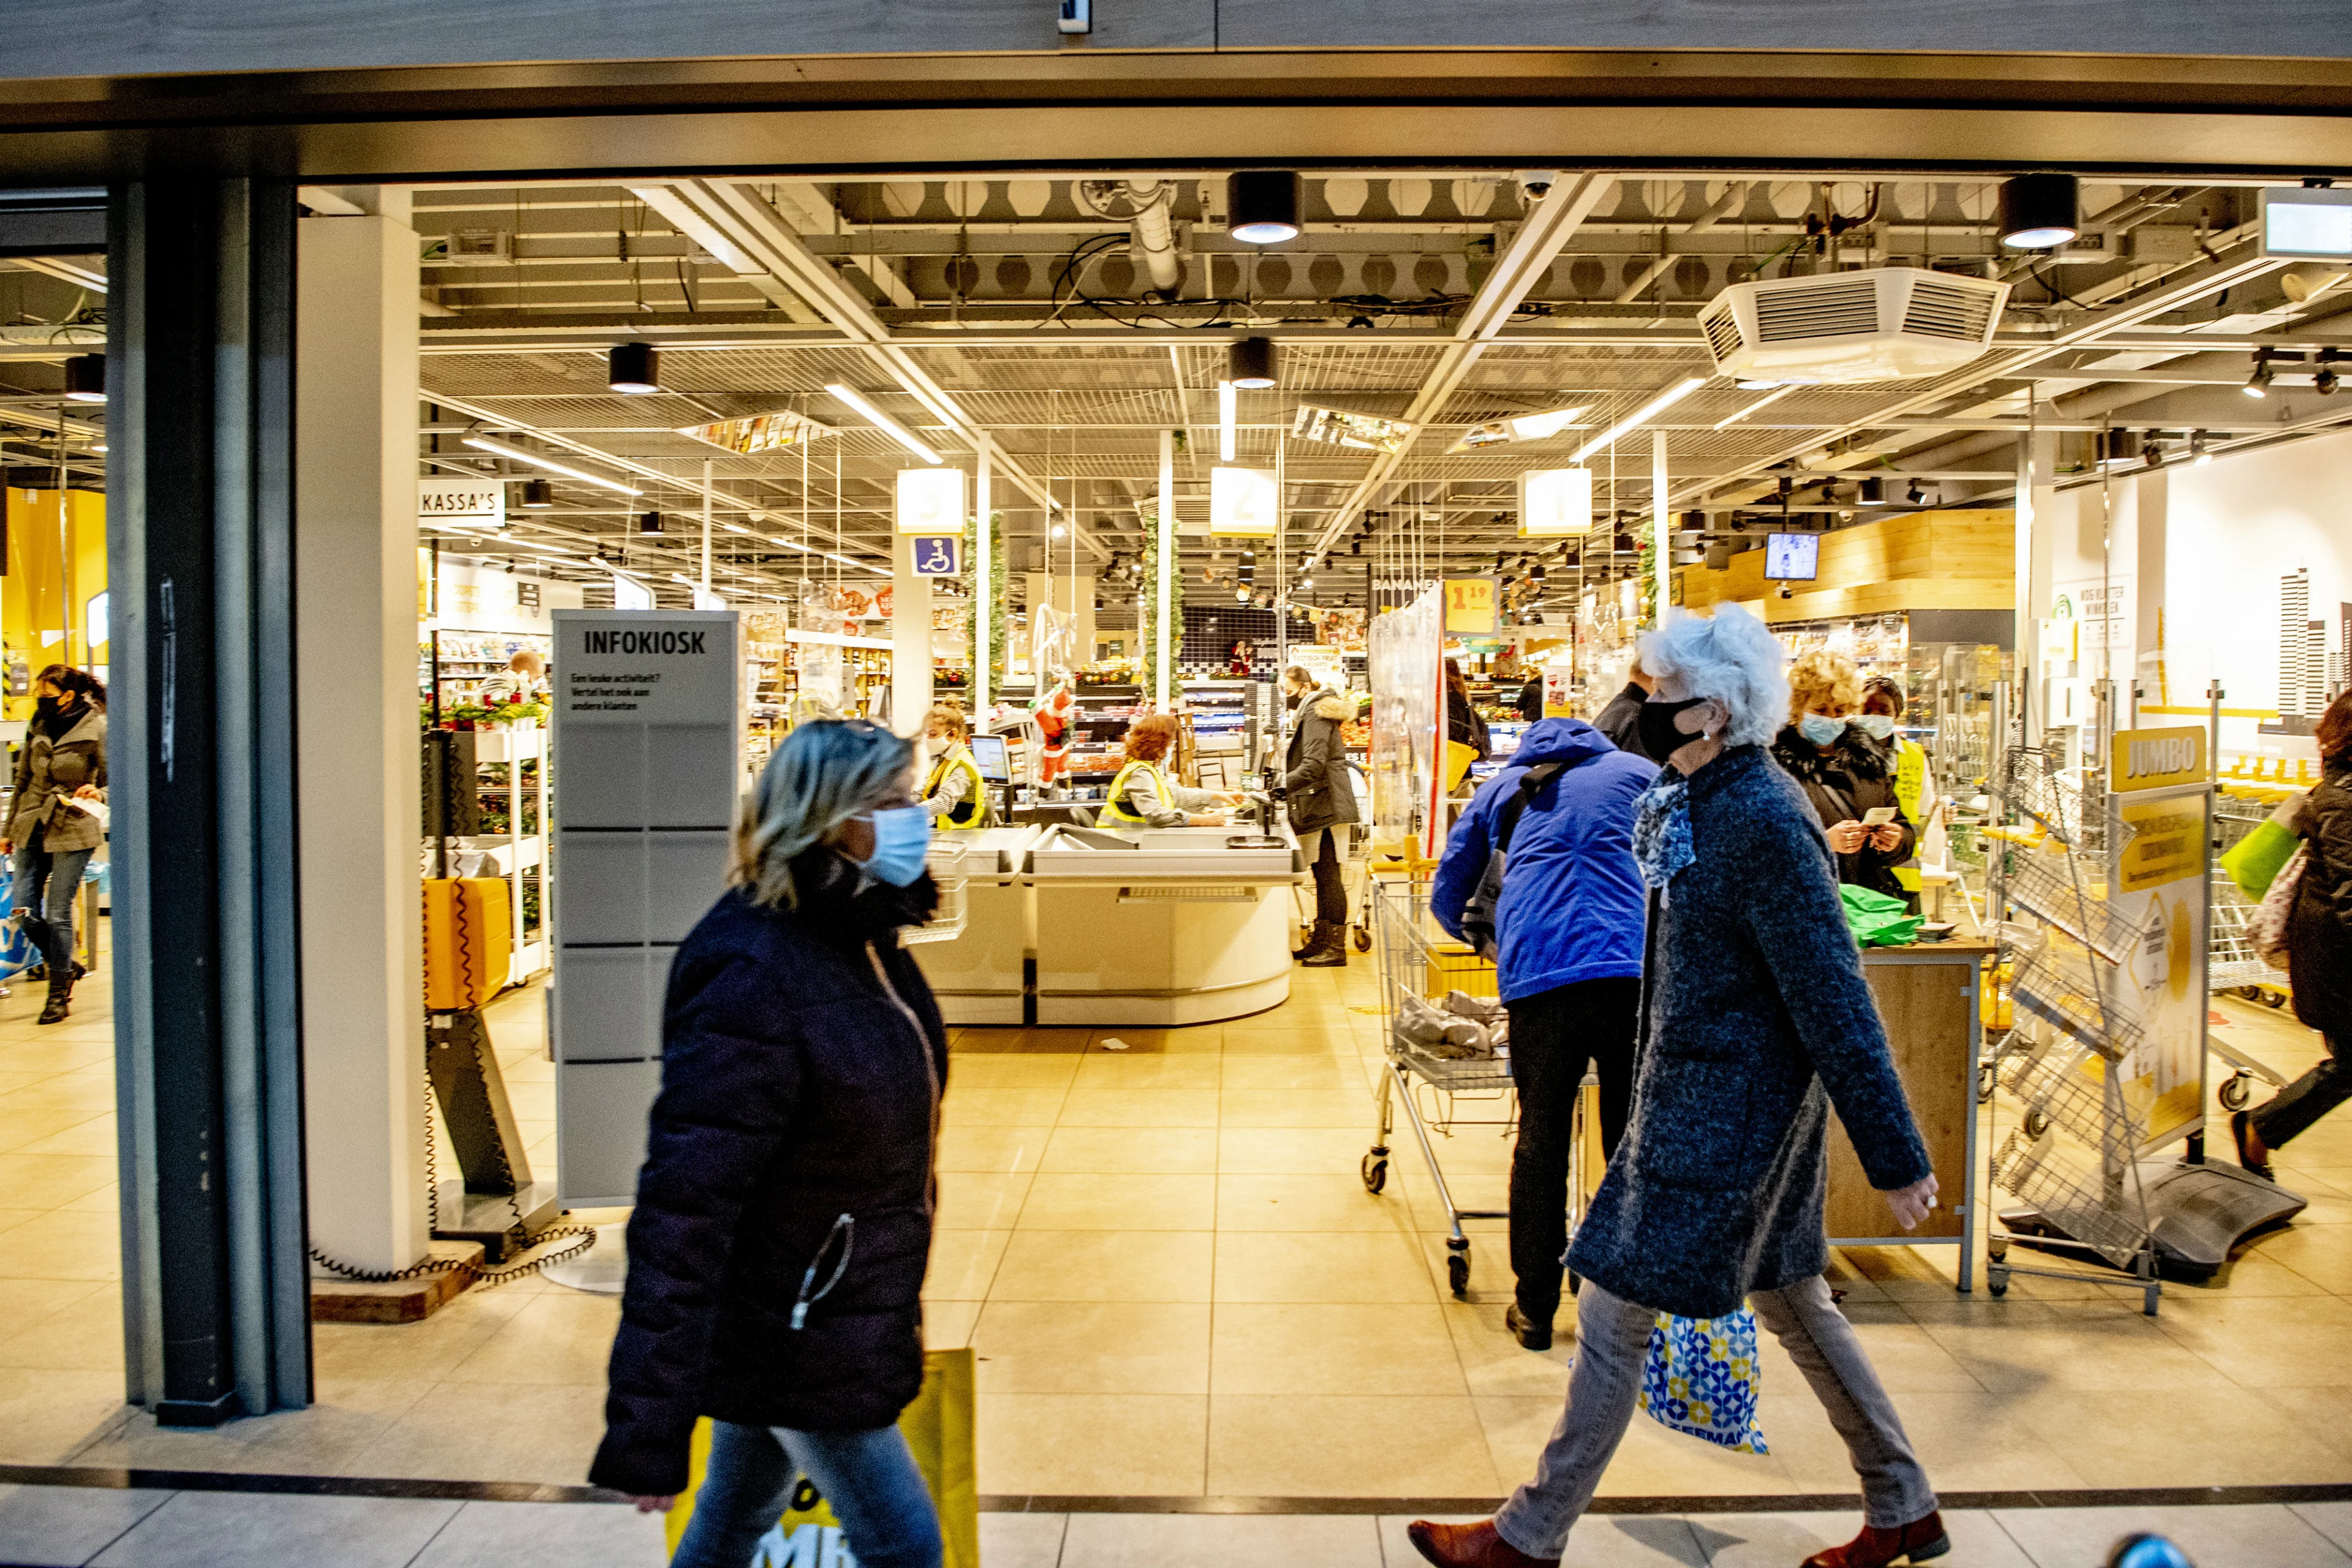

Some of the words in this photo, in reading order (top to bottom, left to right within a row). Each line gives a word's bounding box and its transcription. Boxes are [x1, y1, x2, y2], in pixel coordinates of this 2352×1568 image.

[422, 492, 496, 512] KASSA'S
[1233, 475, 1256, 521] 2
[1547, 478, 1566, 522] 1
[1453, 587, 1466, 609] 1
[1470, 587, 1487, 598] 19
[585, 630, 706, 655] INFOKIOSK
[571, 673, 586, 682] Een
[587, 674, 612, 682] leuke
[571, 687, 599, 696] Vertel
[600, 687, 614, 696] het
[616, 688, 632, 696] ook
[571, 701, 601, 710] andere
[603, 701, 638, 710] klanten
[2126, 737, 2196, 778] JUMBO
